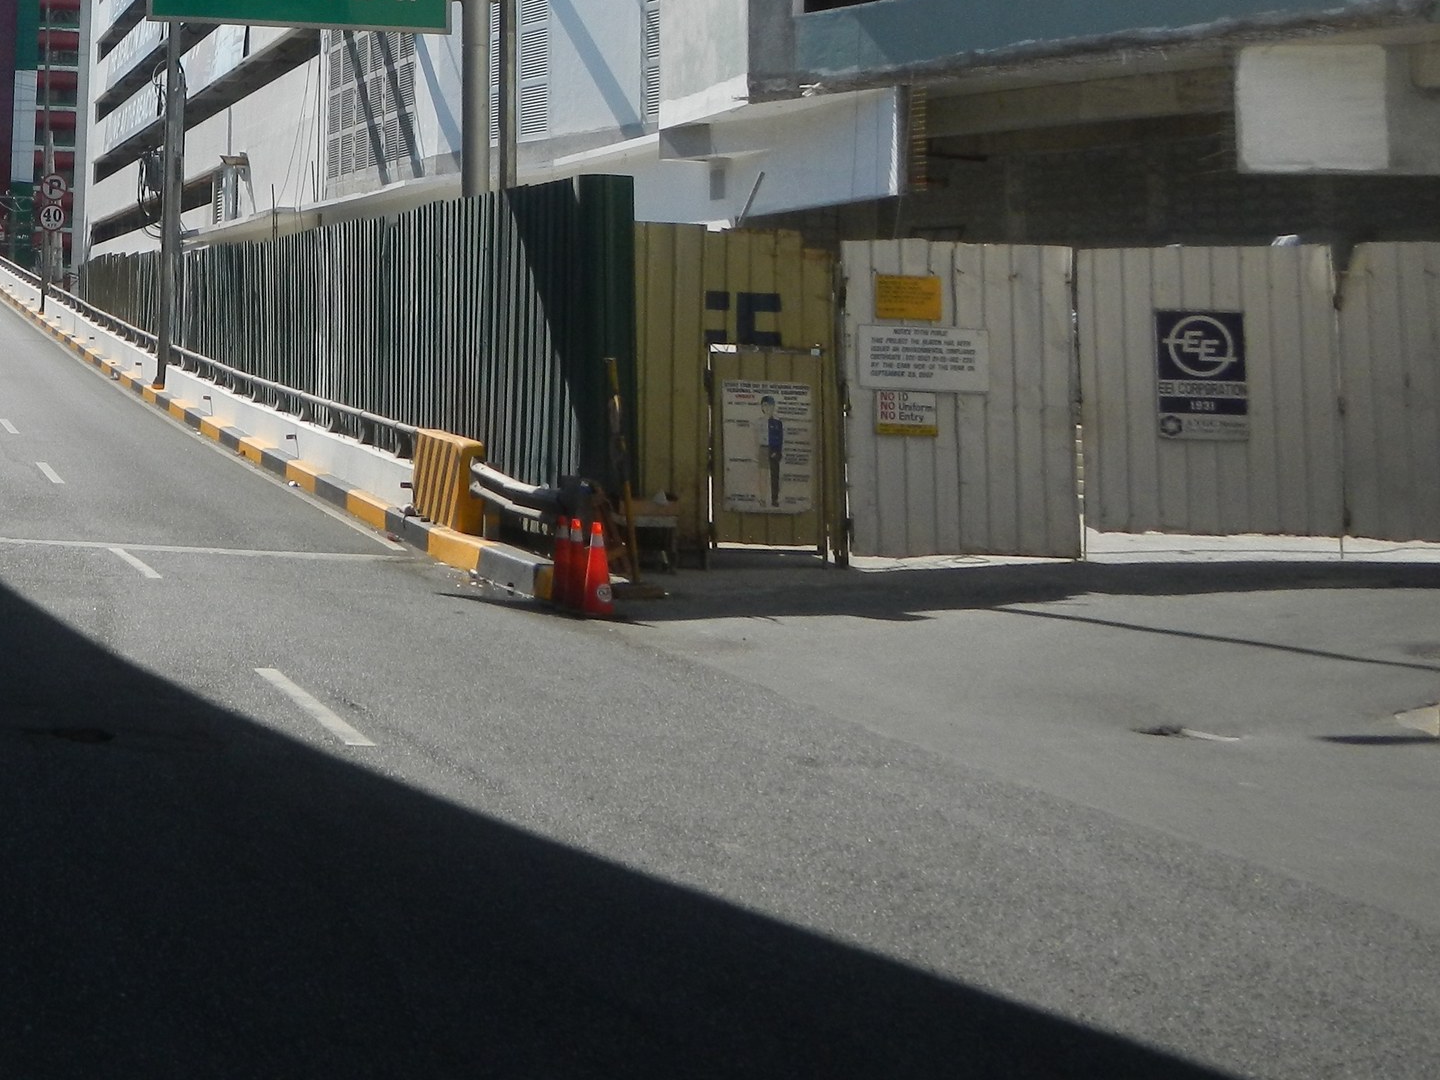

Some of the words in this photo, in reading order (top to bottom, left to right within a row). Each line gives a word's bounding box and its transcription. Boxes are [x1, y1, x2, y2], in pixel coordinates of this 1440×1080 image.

[49, 178, 62, 195] P
[43, 208, 61, 222] 40
[1178, 382, 1247, 396] CORPORATION
[880, 392, 895, 401] NO
[898, 392, 909, 401] ID
[880, 402, 895, 410] NO
[880, 411, 896, 420] NO
[898, 412, 924, 423] Entry
